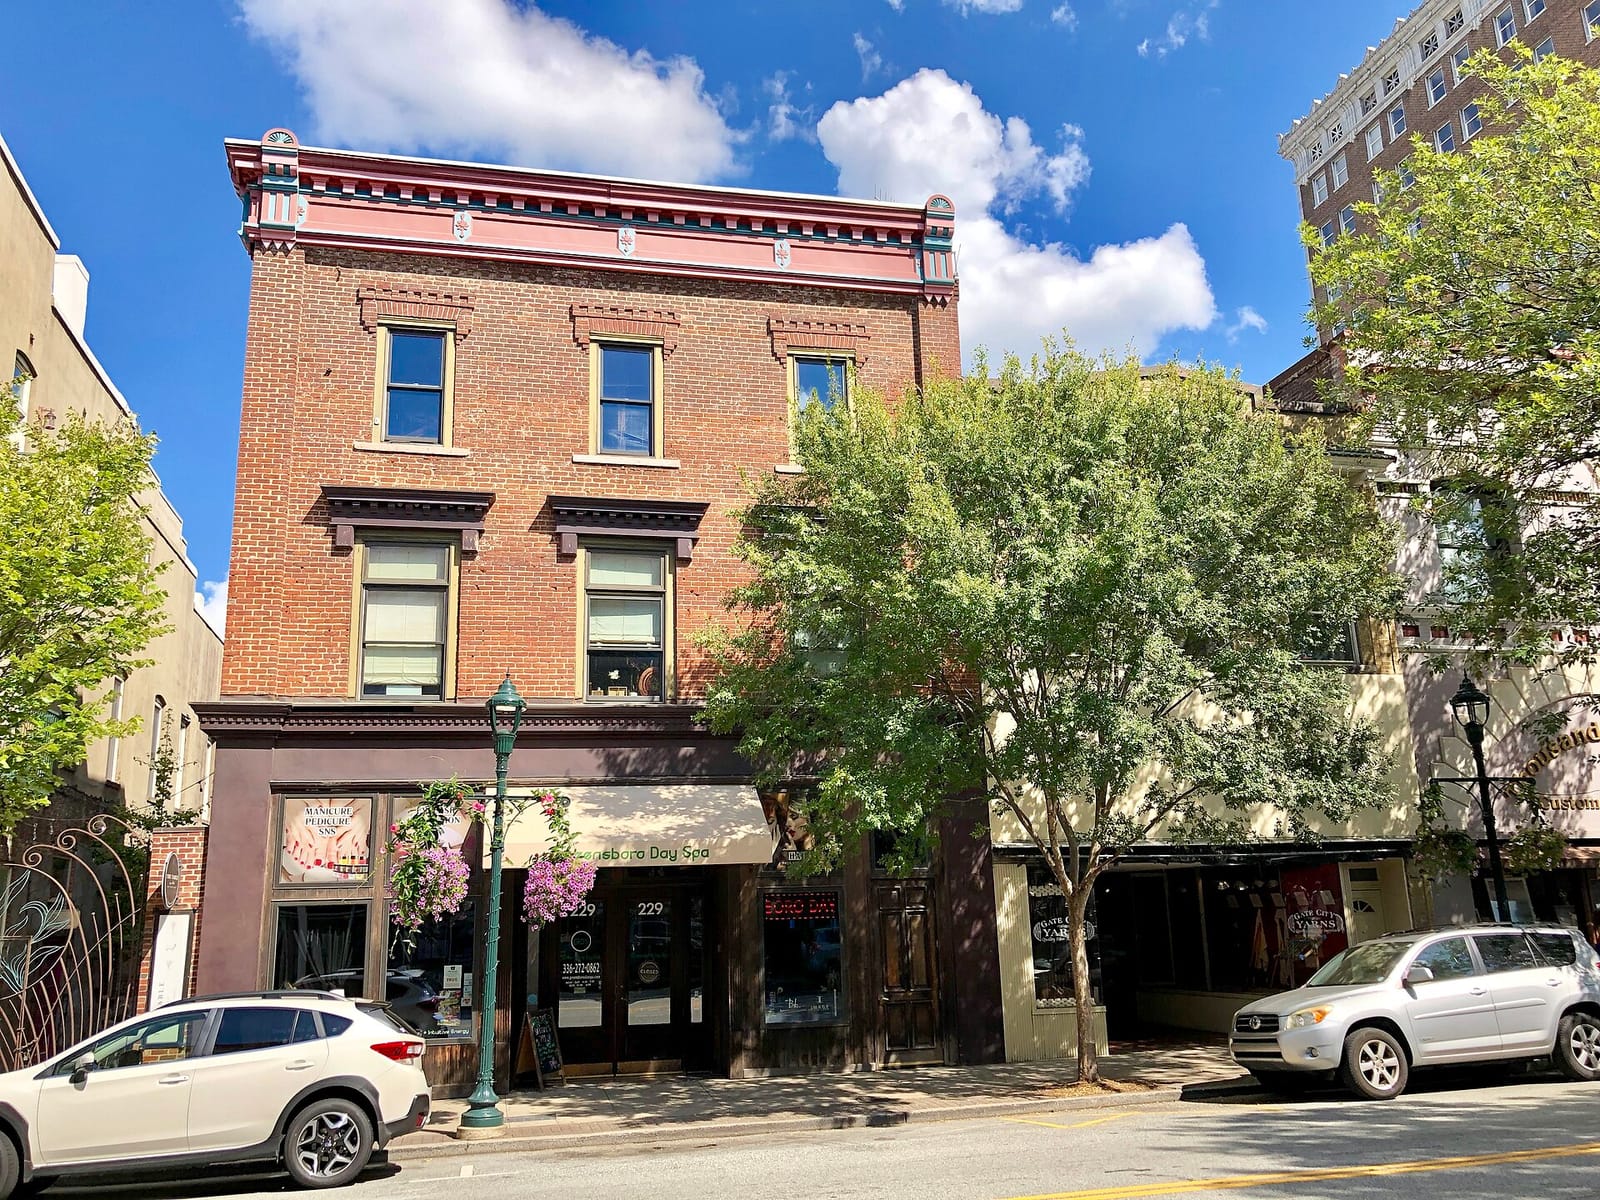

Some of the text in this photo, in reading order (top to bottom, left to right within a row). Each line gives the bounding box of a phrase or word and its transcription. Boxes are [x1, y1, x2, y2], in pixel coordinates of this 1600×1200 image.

[304, 807, 353, 816] MANICURE
[305, 818, 351, 826] PEDICURE
[318, 828, 336, 836] SNS
[650, 846, 678, 861] Day
[682, 845, 710, 861] Spa
[638, 902, 663, 916] 229
[1294, 908, 1336, 920] GATE CITY
[1041, 917, 1063, 928] GATE
[1296, 920, 1336, 929] YARNS
[562, 962, 600, 974] 336-272-0862
